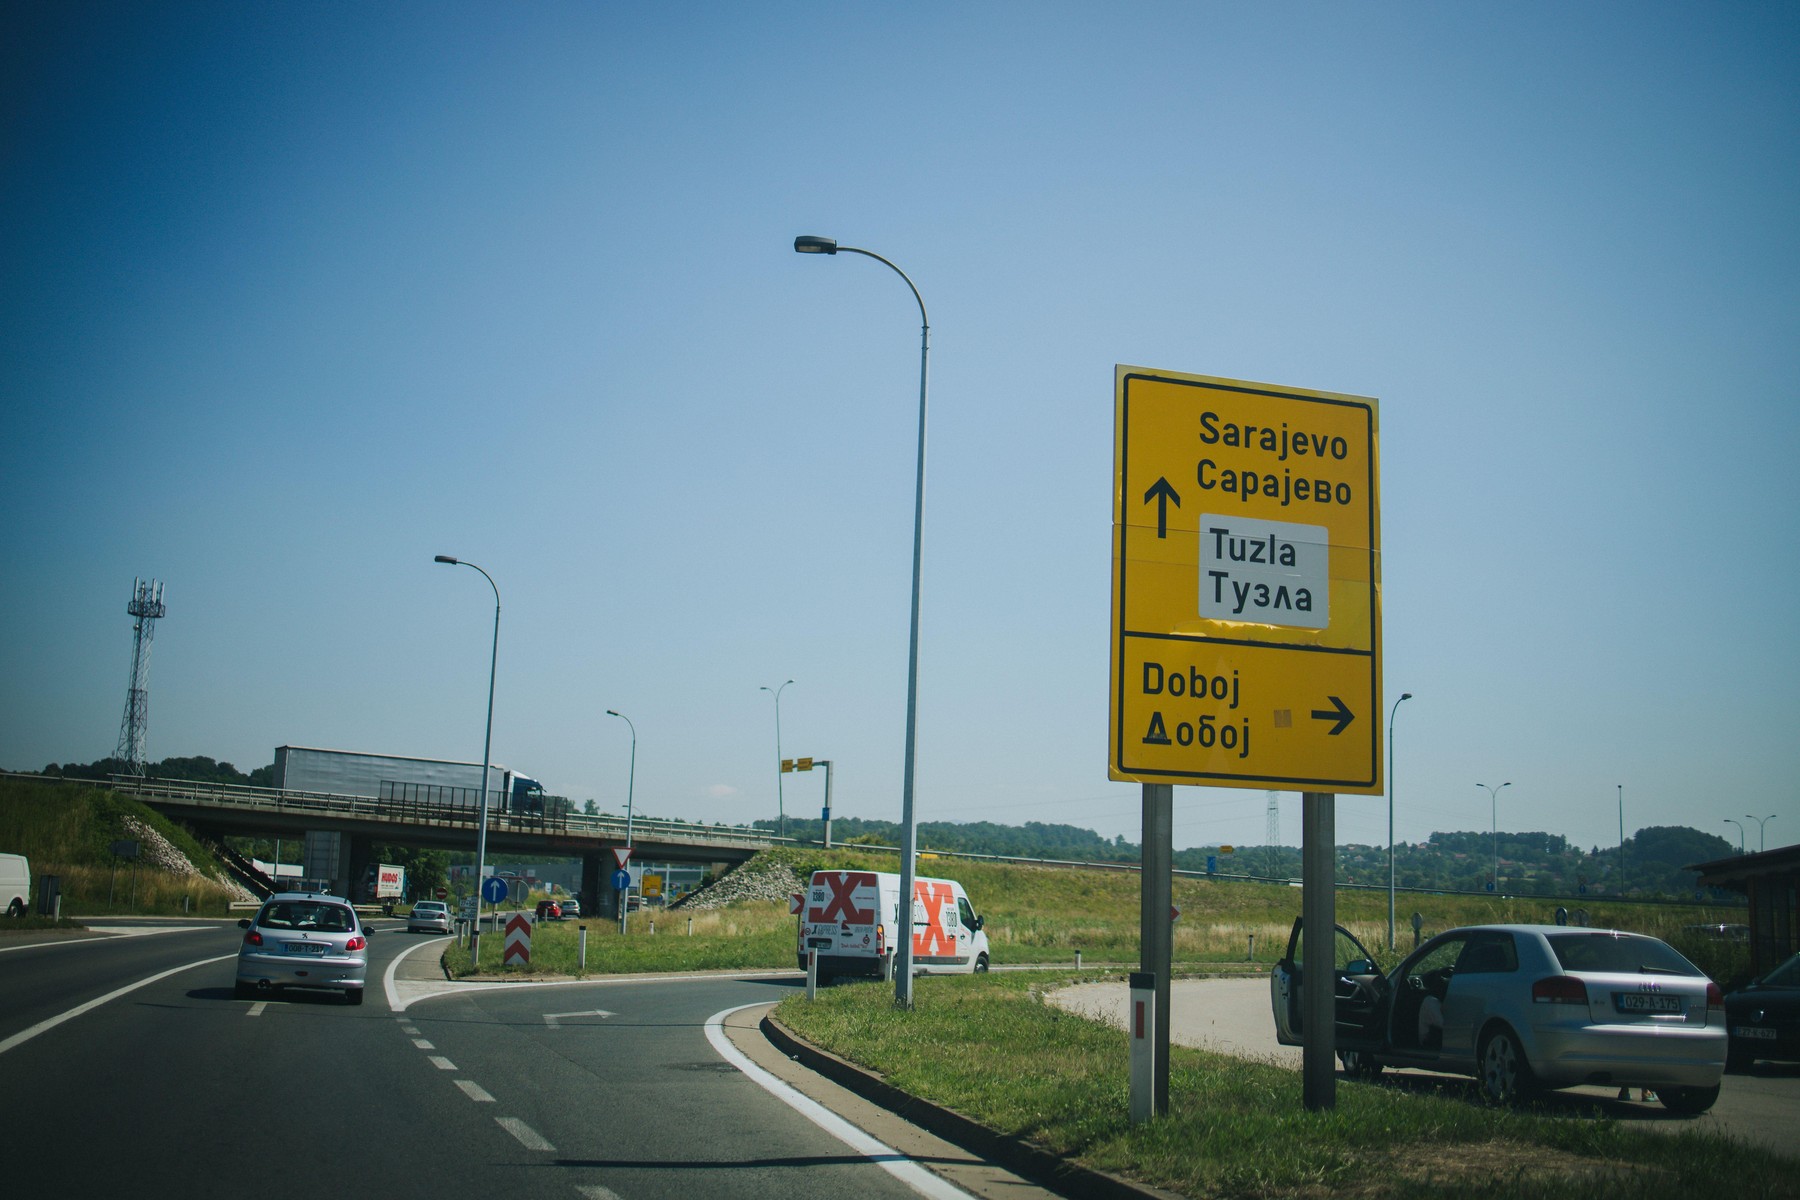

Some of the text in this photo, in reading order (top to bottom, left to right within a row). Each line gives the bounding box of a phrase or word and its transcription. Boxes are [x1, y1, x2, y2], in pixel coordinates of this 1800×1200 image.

[1199, 411, 1348, 461] Sarajevo
[1197, 458, 1352, 507] Сарајево
[1209, 527, 1296, 567] Tuzla
[1208, 570, 1312, 614] Тузла
[1143, 661, 1239, 709] Doboj
[1142, 711, 1249, 758] Добој
[812, 891, 825, 902] 1380
[1625, 995, 1679, 1010] 029-A-175
